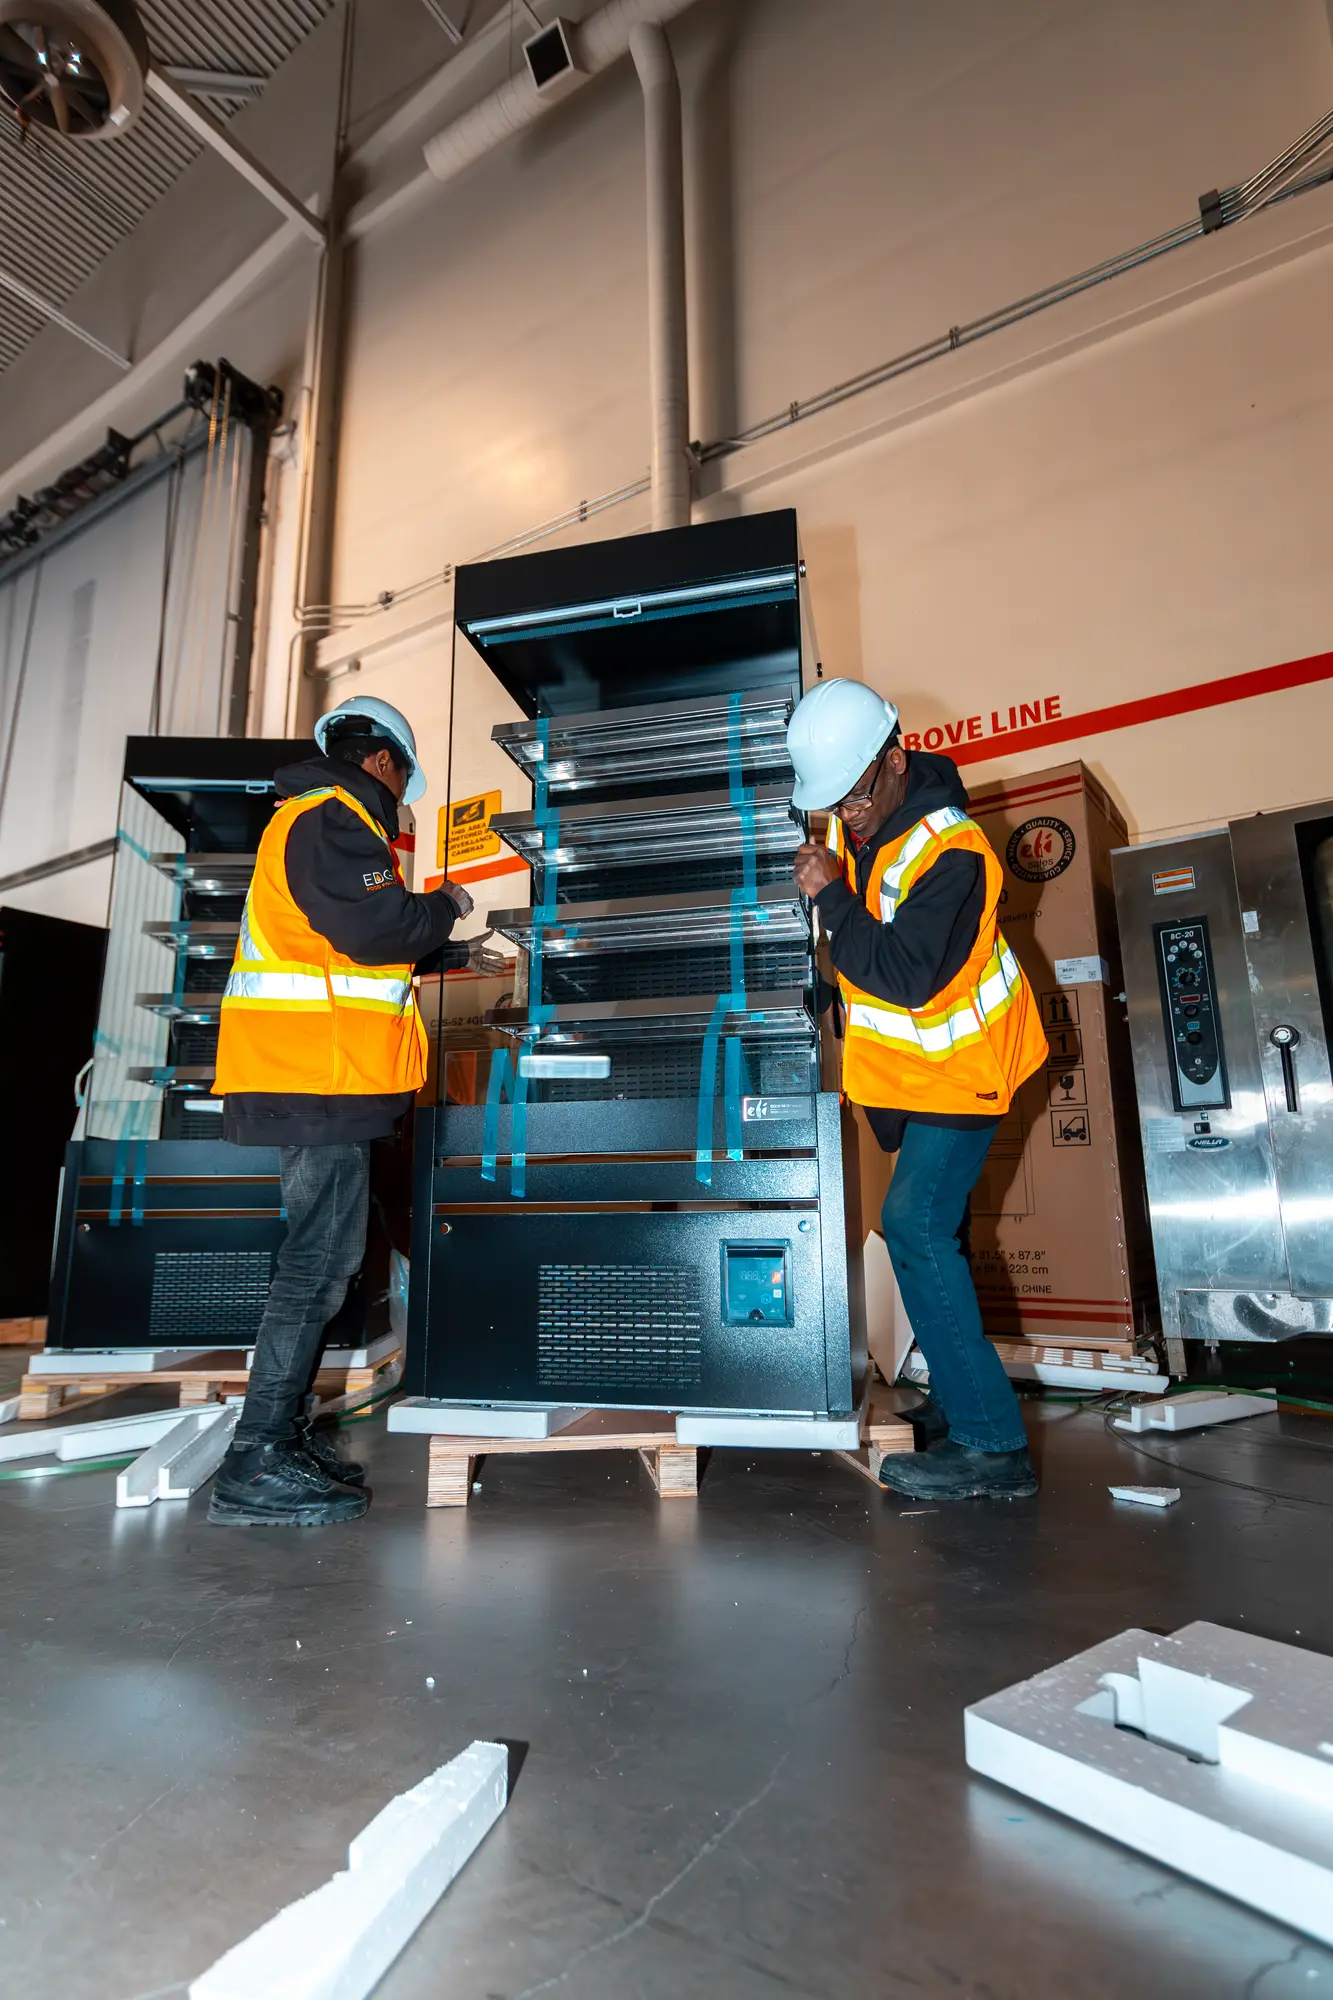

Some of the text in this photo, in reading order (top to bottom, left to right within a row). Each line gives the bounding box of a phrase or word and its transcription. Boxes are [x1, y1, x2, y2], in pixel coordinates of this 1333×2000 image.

[904, 695, 1062, 752] BOVE LINE
[451, 822, 486, 836] THIS AREA
[1025, 819, 1060, 830] QUALITY
[444, 834, 493, 852] URVEILLANCE
[1008, 833, 1021, 858] VALUE
[1062, 830, 1073, 861] SERVICE
[451, 844, 484, 857] CAMERAS
[1028, 858, 1054, 869] sales
[363, 869, 396, 886] EDG
[1170, 931, 1194, 940] BC-20
[1057, 1033, 1067, 1053] 1
[1009, 1252, 1015, 1260] x
[1018, 1250, 1046, 1260] 87.8"
[1009, 1264, 1029, 1274] 223
[1031, 1266, 1049, 1274] cm
[1021, 1284, 1053, 1294] CHINE
